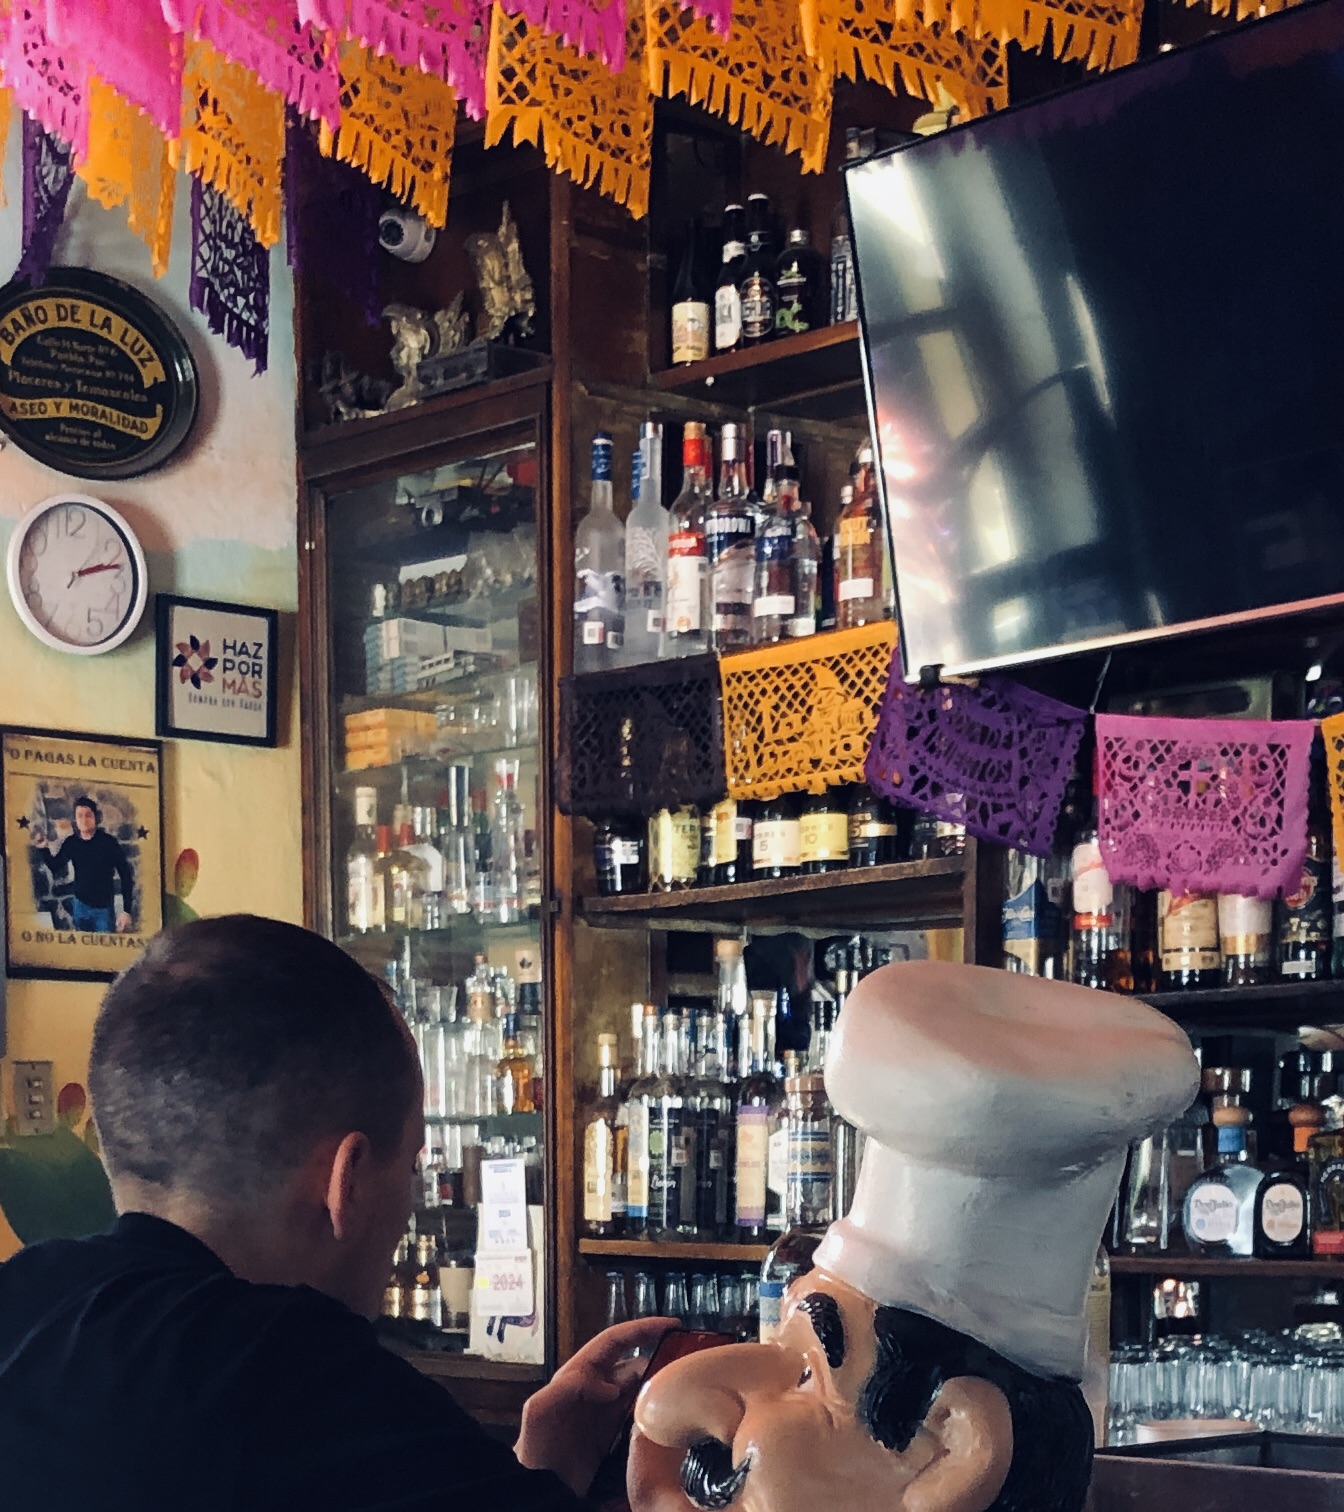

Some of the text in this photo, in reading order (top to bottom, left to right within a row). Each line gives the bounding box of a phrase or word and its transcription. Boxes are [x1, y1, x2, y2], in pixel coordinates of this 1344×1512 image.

[56, 303, 82, 323] DE
[89, 309, 112, 335] LA
[119, 328, 155, 369] LUZ
[9, 401, 148, 434] ASEO Y MORALIDAD
[65, 507, 86, 538] 12
[223, 638, 263, 659] HAZ
[223, 658, 263, 679] POR
[24, 749, 75, 765] PAGAS
[79, 754, 97, 767] LA
[101, 757, 155, 773] CUENTA
[36, 931, 54, 943] NO
[58, 933, 77, 944] LA
